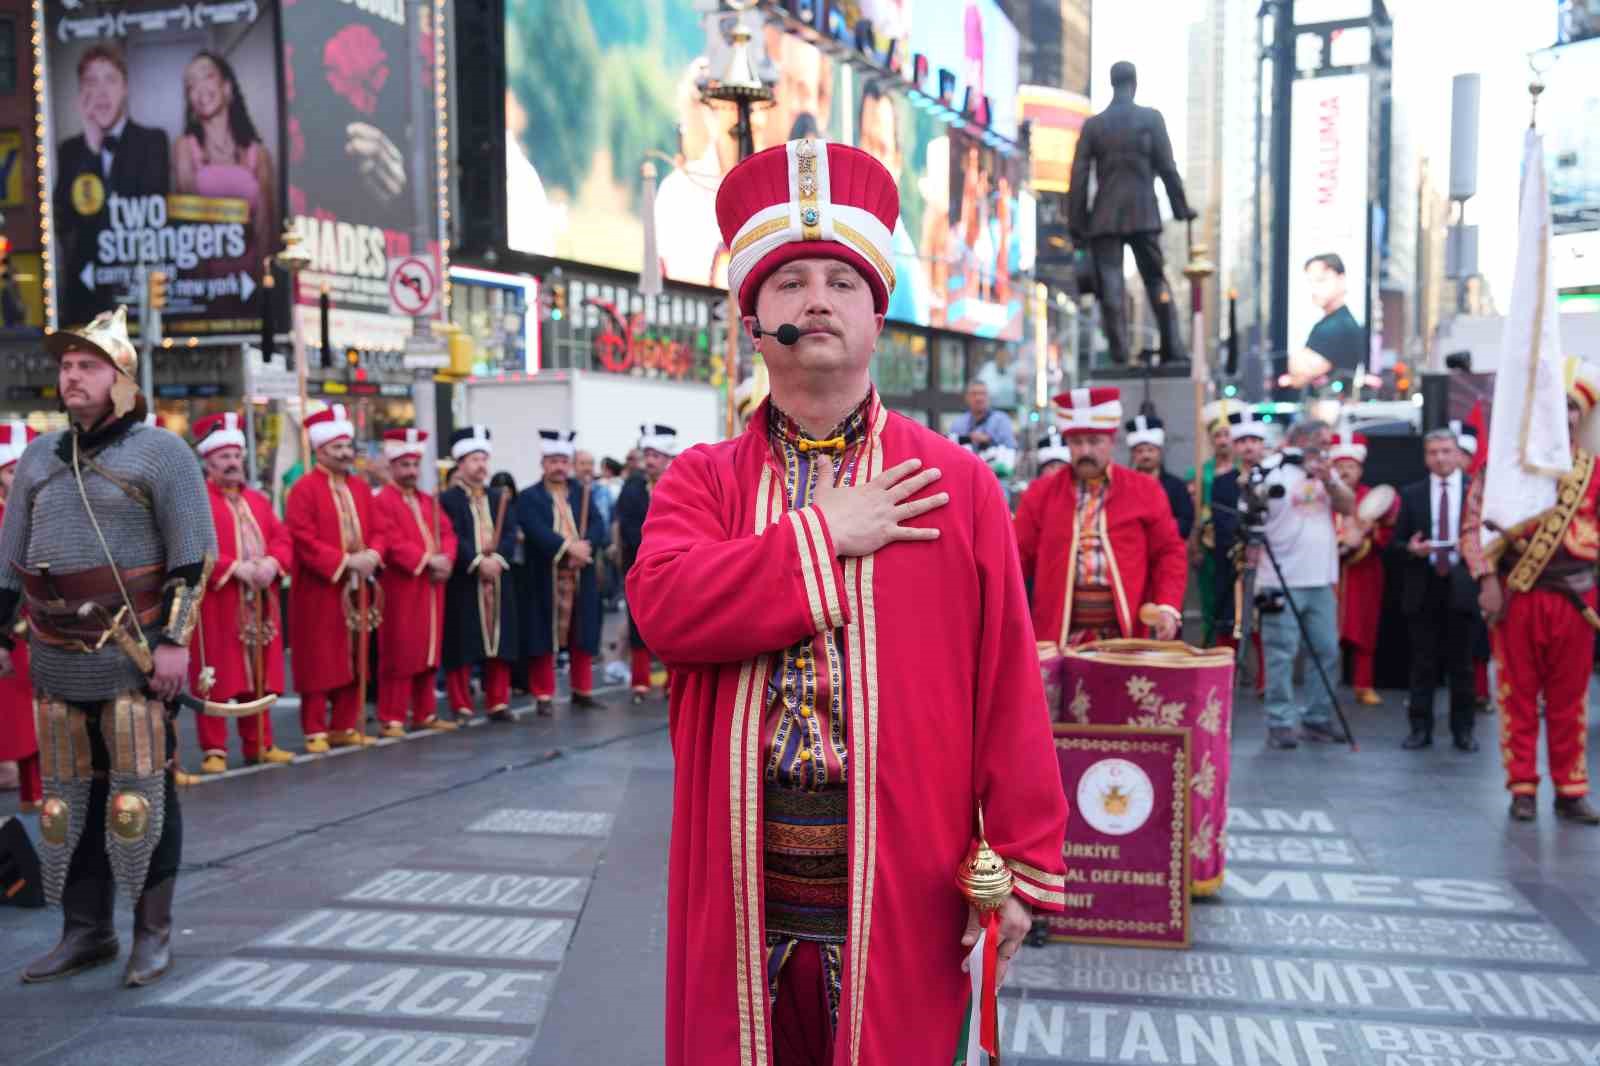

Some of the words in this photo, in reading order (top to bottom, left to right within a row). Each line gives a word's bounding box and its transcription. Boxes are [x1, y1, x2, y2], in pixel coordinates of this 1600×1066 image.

[1317, 96, 1339, 205] MALUMA
[108, 192, 167, 229] two
[97, 222, 246, 270] strangers
[1061, 841, 1121, 859] ÜRKİYE
[342, 869, 582, 908] BELASCO
[1064, 868, 1089, 882] AL
[1091, 869, 1167, 886] DEFENSE
[1223, 869, 1516, 912] MES
[1064, 893, 1096, 909] NIT
[265, 909, 566, 954] LYCEUM
[1264, 909, 1553, 944] MAJESTIC
[159, 958, 545, 1019] PALACE
[999, 1002, 1337, 1066] NTANNE
